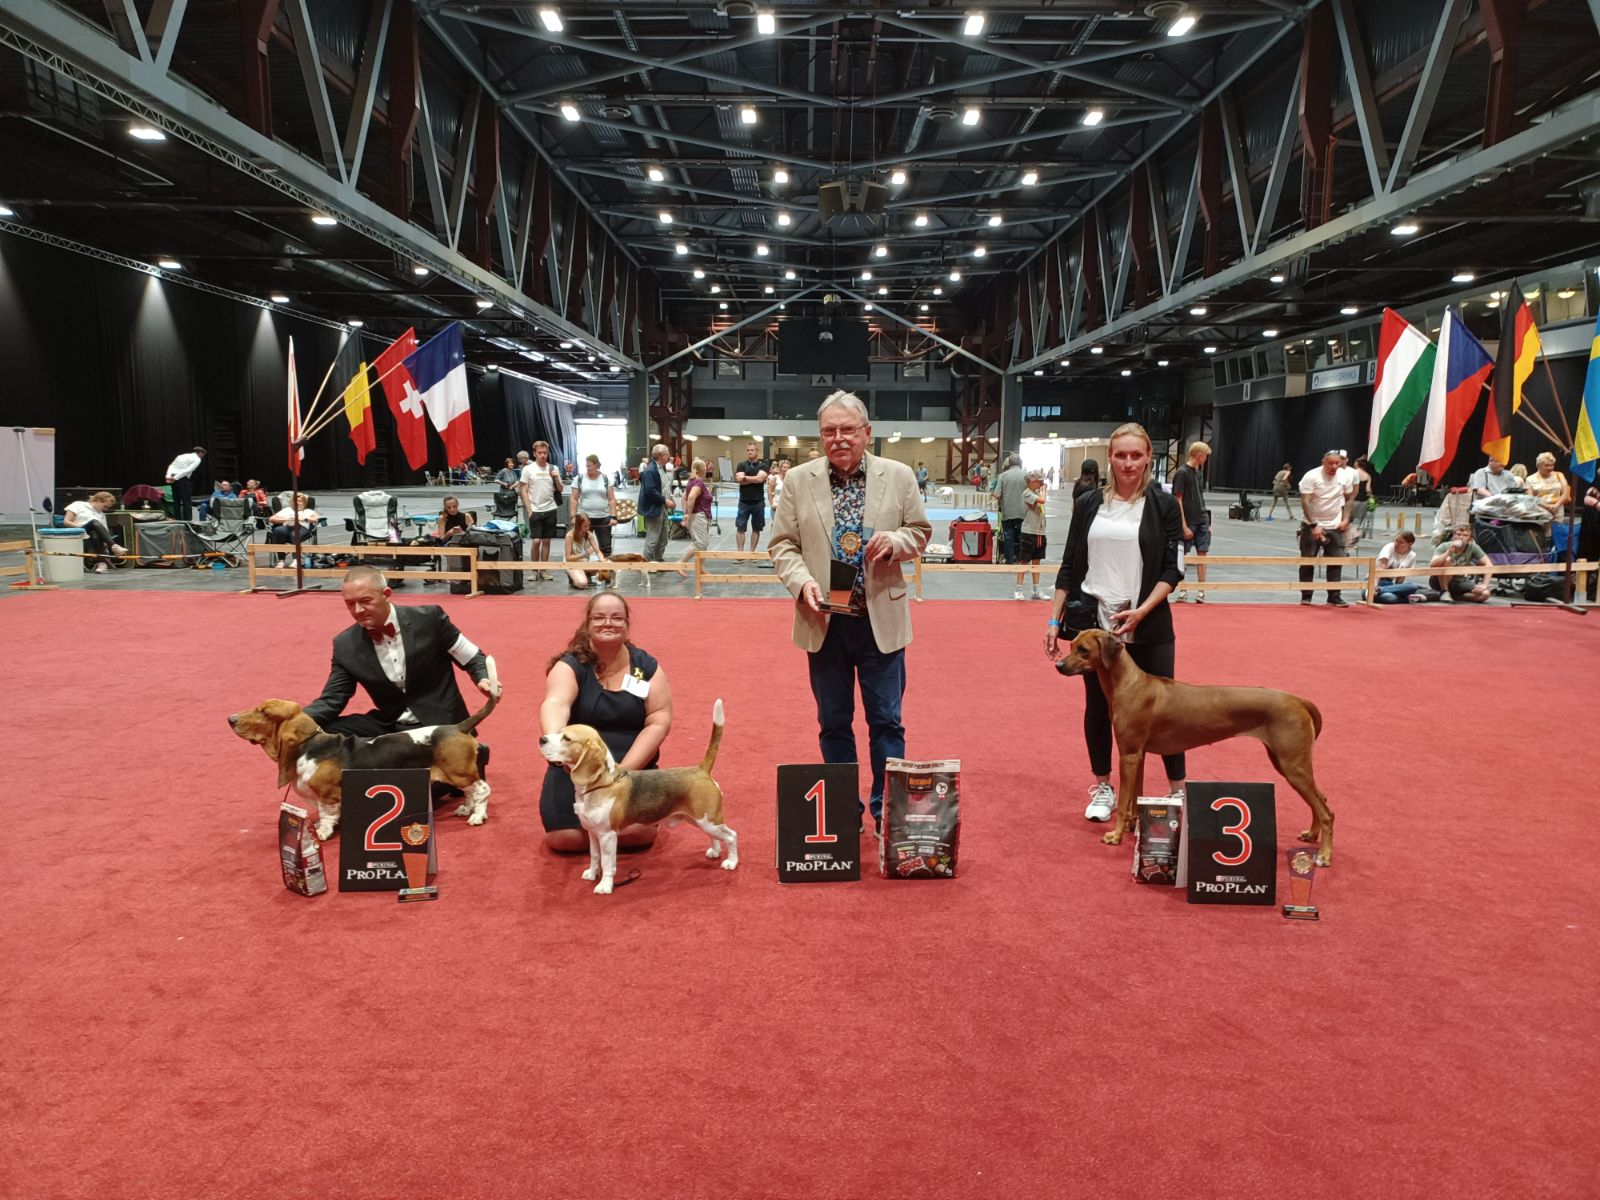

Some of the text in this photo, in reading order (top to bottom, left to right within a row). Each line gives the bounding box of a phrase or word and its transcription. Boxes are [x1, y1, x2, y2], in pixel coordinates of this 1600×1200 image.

[1369, 362, 1376, 381] B
[364, 784, 405, 851] 2
[804, 779, 838, 843] 1
[1210, 796, 1252, 866] 3
